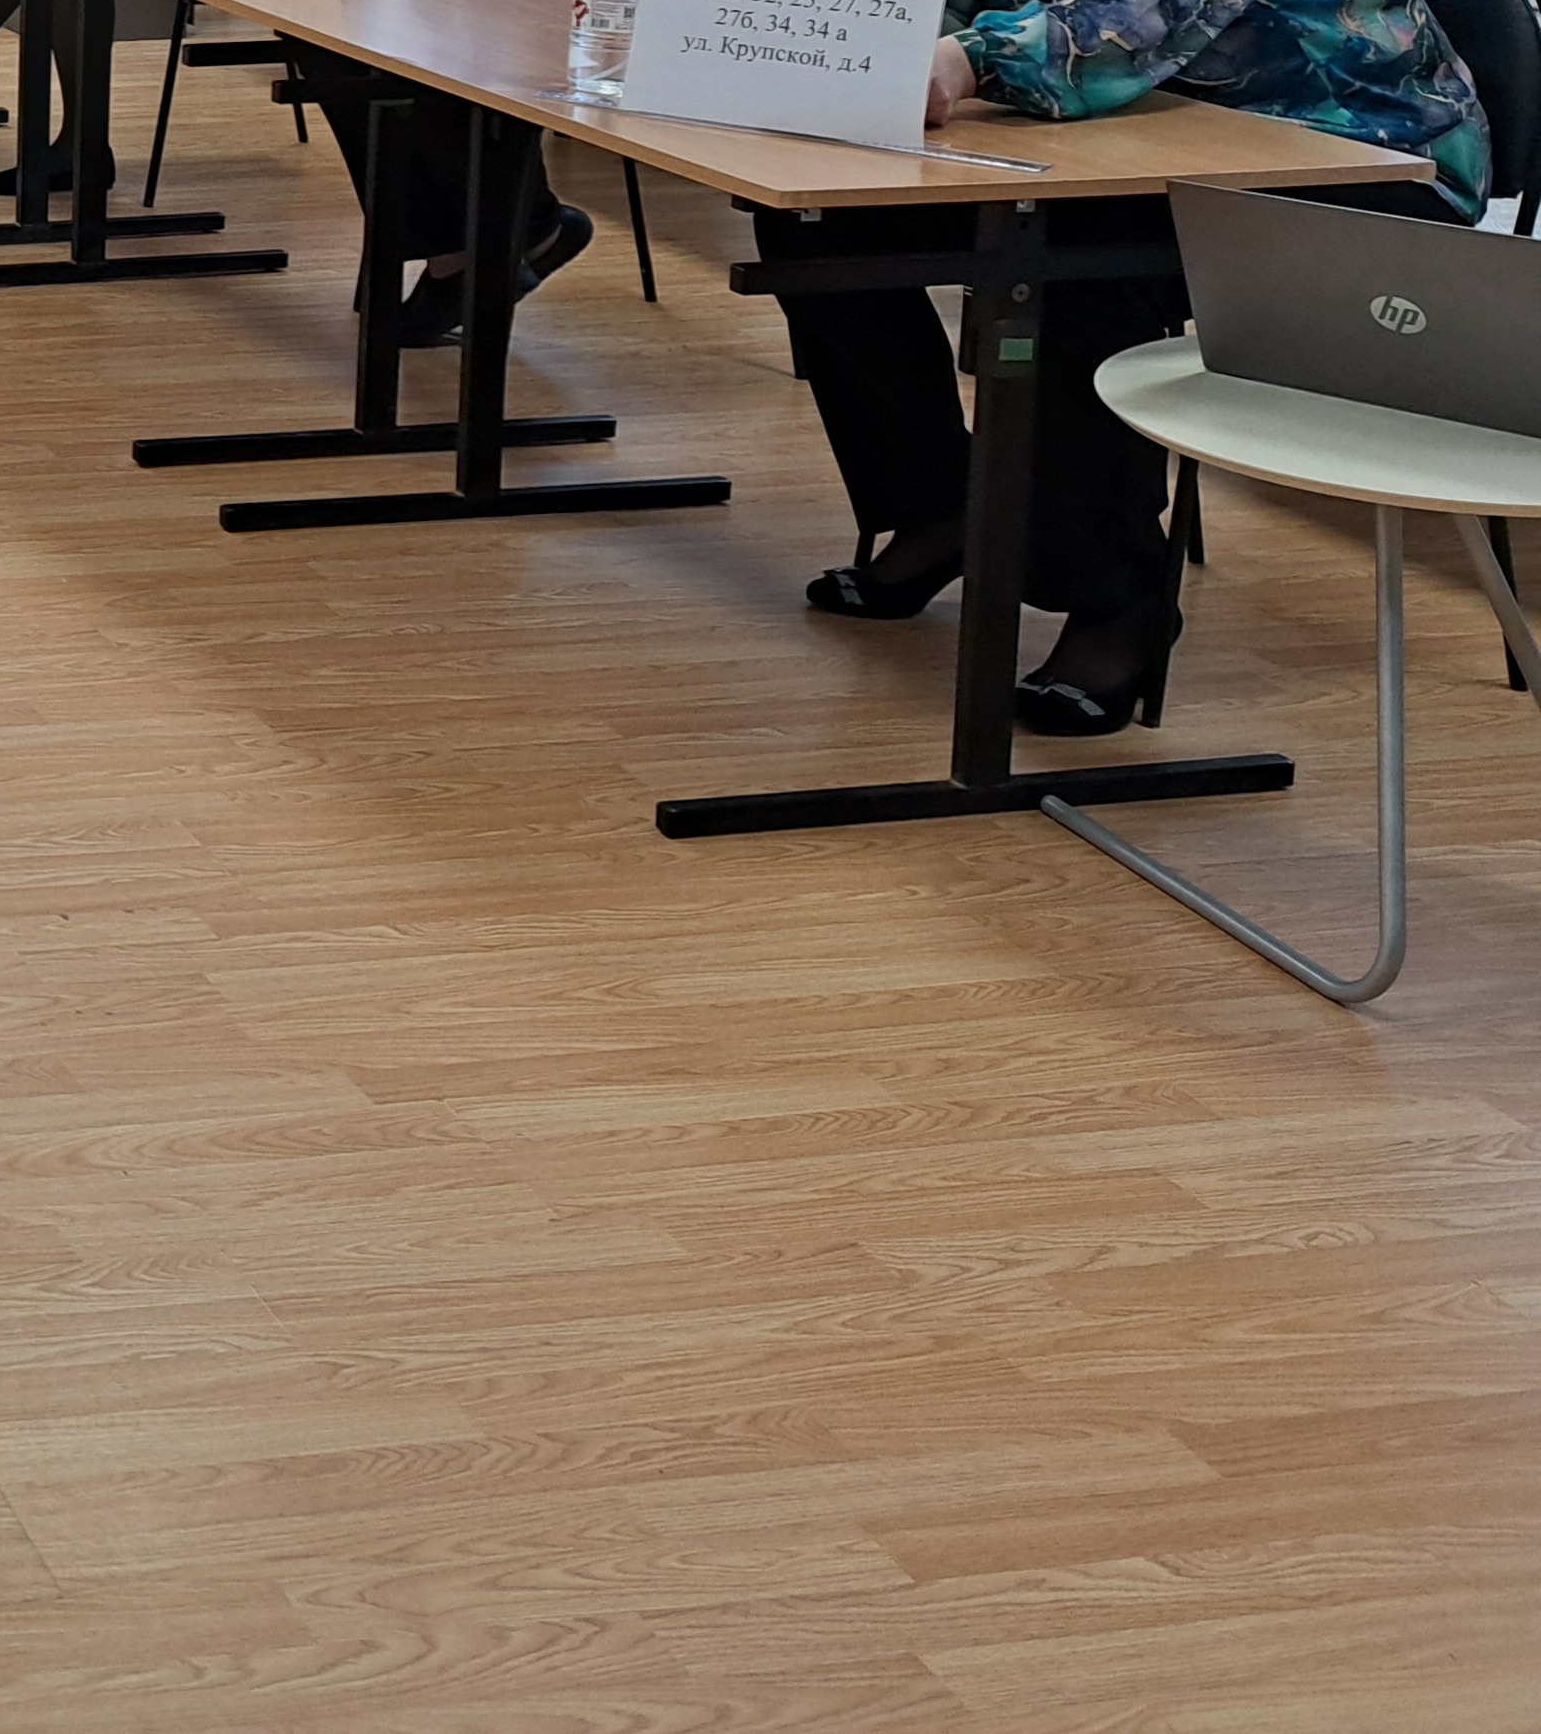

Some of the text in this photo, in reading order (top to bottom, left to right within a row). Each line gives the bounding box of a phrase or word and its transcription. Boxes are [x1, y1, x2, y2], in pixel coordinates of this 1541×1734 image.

[765, 14, 797, 38] 34,
[803, 18, 830, 39] 34
[835, 28, 848, 42] а
[868, 0, 914, 24] 27а,
[680, 35, 872, 73] ул. Крупской, д.4
[1375, 295, 1423, 334] hp
